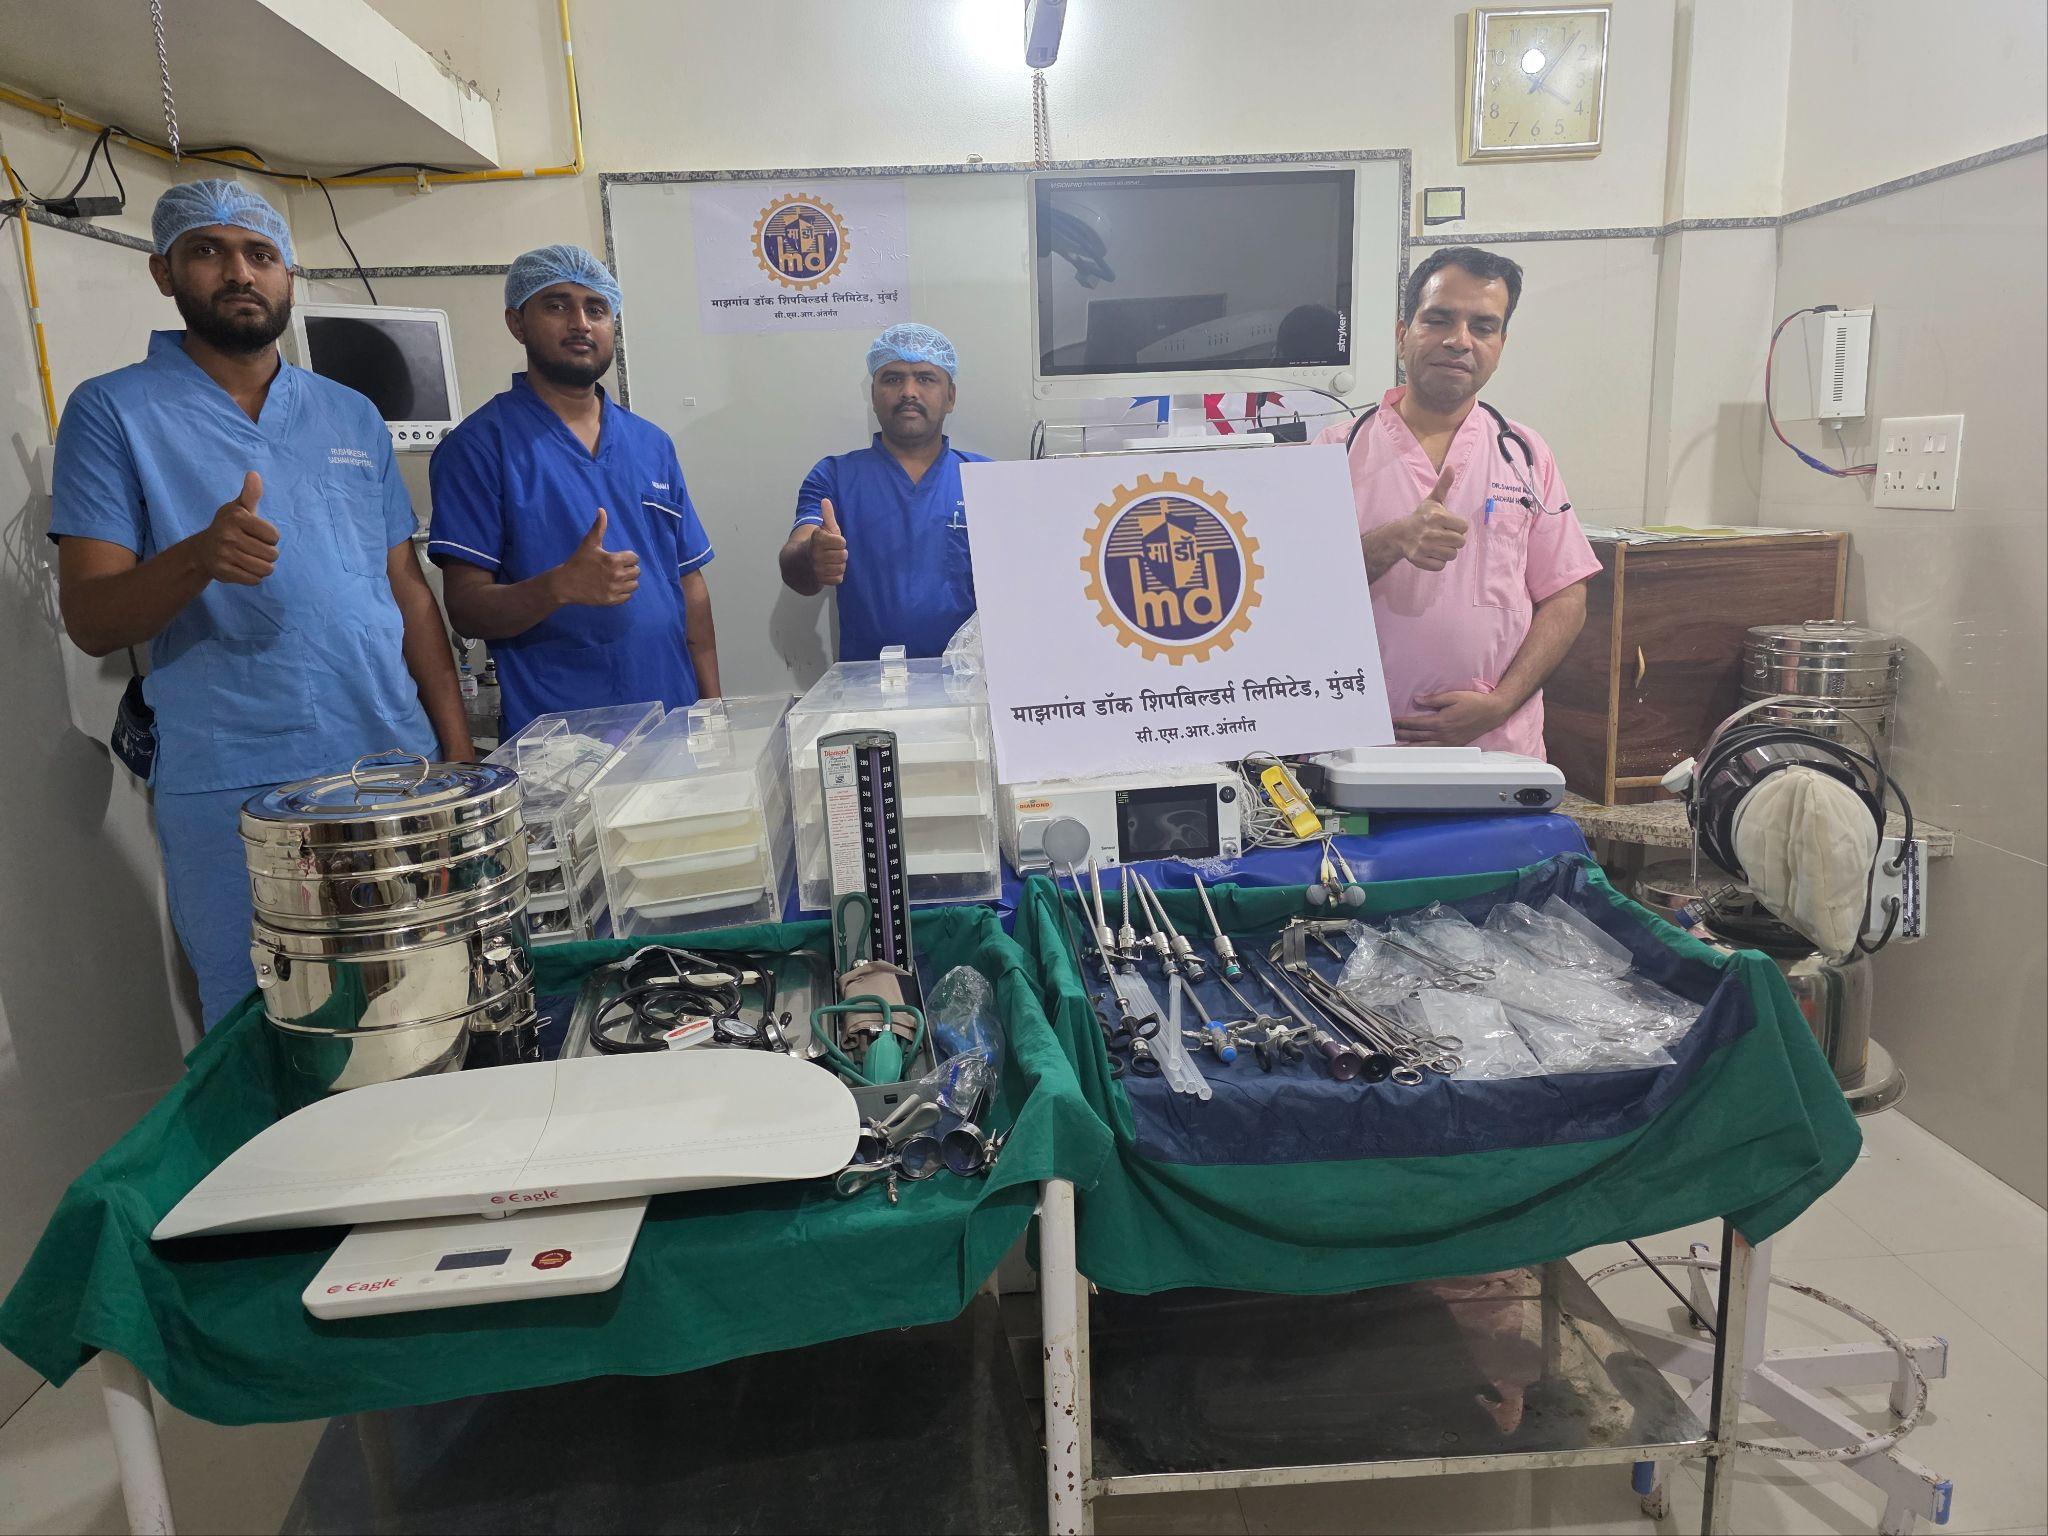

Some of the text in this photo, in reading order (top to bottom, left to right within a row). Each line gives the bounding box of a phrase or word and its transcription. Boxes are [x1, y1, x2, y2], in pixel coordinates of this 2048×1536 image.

[1489, 48, 1506, 66] 10
[1578, 44, 1588, 61] 2
[1576, 72, 1585, 88] 3
[1489, 103, 1500, 119] 8
[1574, 100, 1584, 116] 4
[1508, 121, 1519, 137] 7
[1531, 120, 1541, 137] 6
[1555, 119, 1565, 135] 5
[711, 289, 898, 307] माझगांव डॉक शिपबिल्डर्स लिमिटेड, मुंबई
[1147, 541, 1168, 564] मा
[1010, 667, 1367, 724] माझगांव डॉक शिपबिल्डर्स लिमिटेड, मुंबई
[824, 749, 849, 757] Diamond
[1019, 801, 1050, 809] DIAMOND
[508, 1189, 559, 1206] Eagle
[346, 1277, 400, 1293] Eagle
